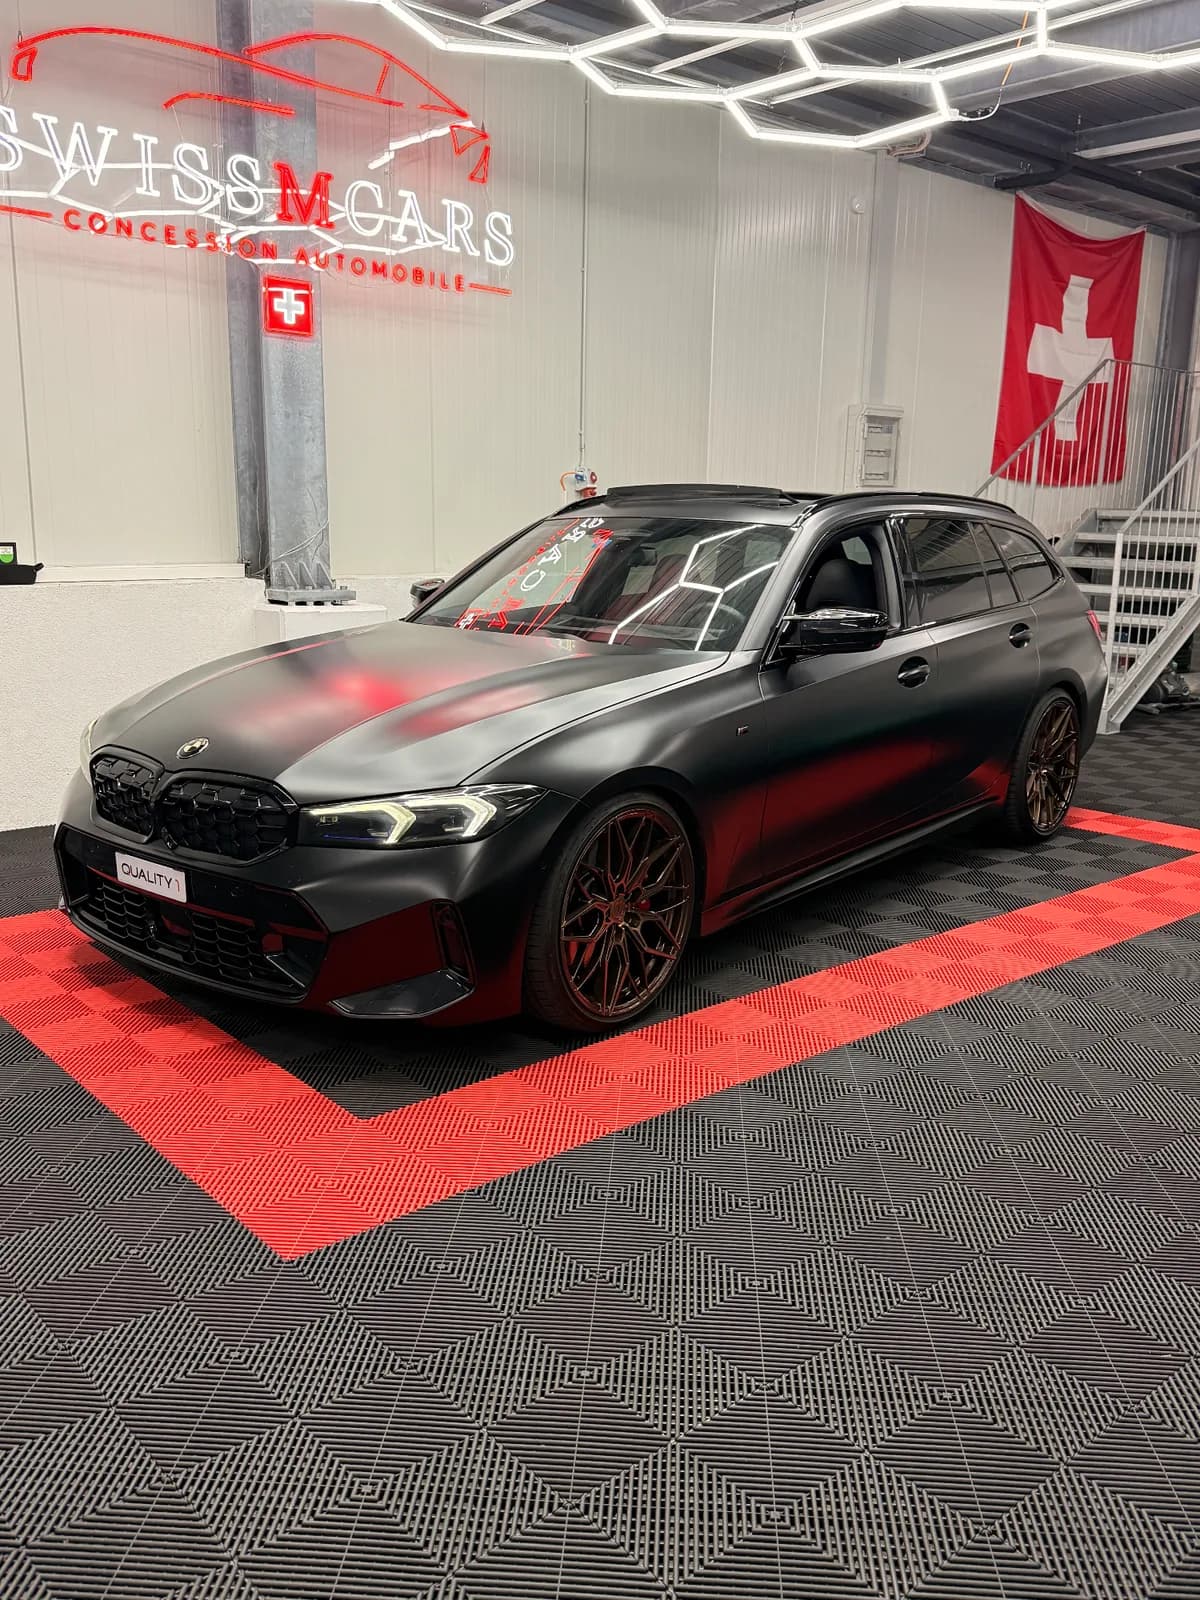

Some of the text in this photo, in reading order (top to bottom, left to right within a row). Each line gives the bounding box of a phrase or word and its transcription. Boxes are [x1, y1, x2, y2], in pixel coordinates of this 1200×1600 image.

[63, 208, 466, 293] CONCESSION AUTOMOBILE
[121, 863, 180, 893] QUALITY 1
